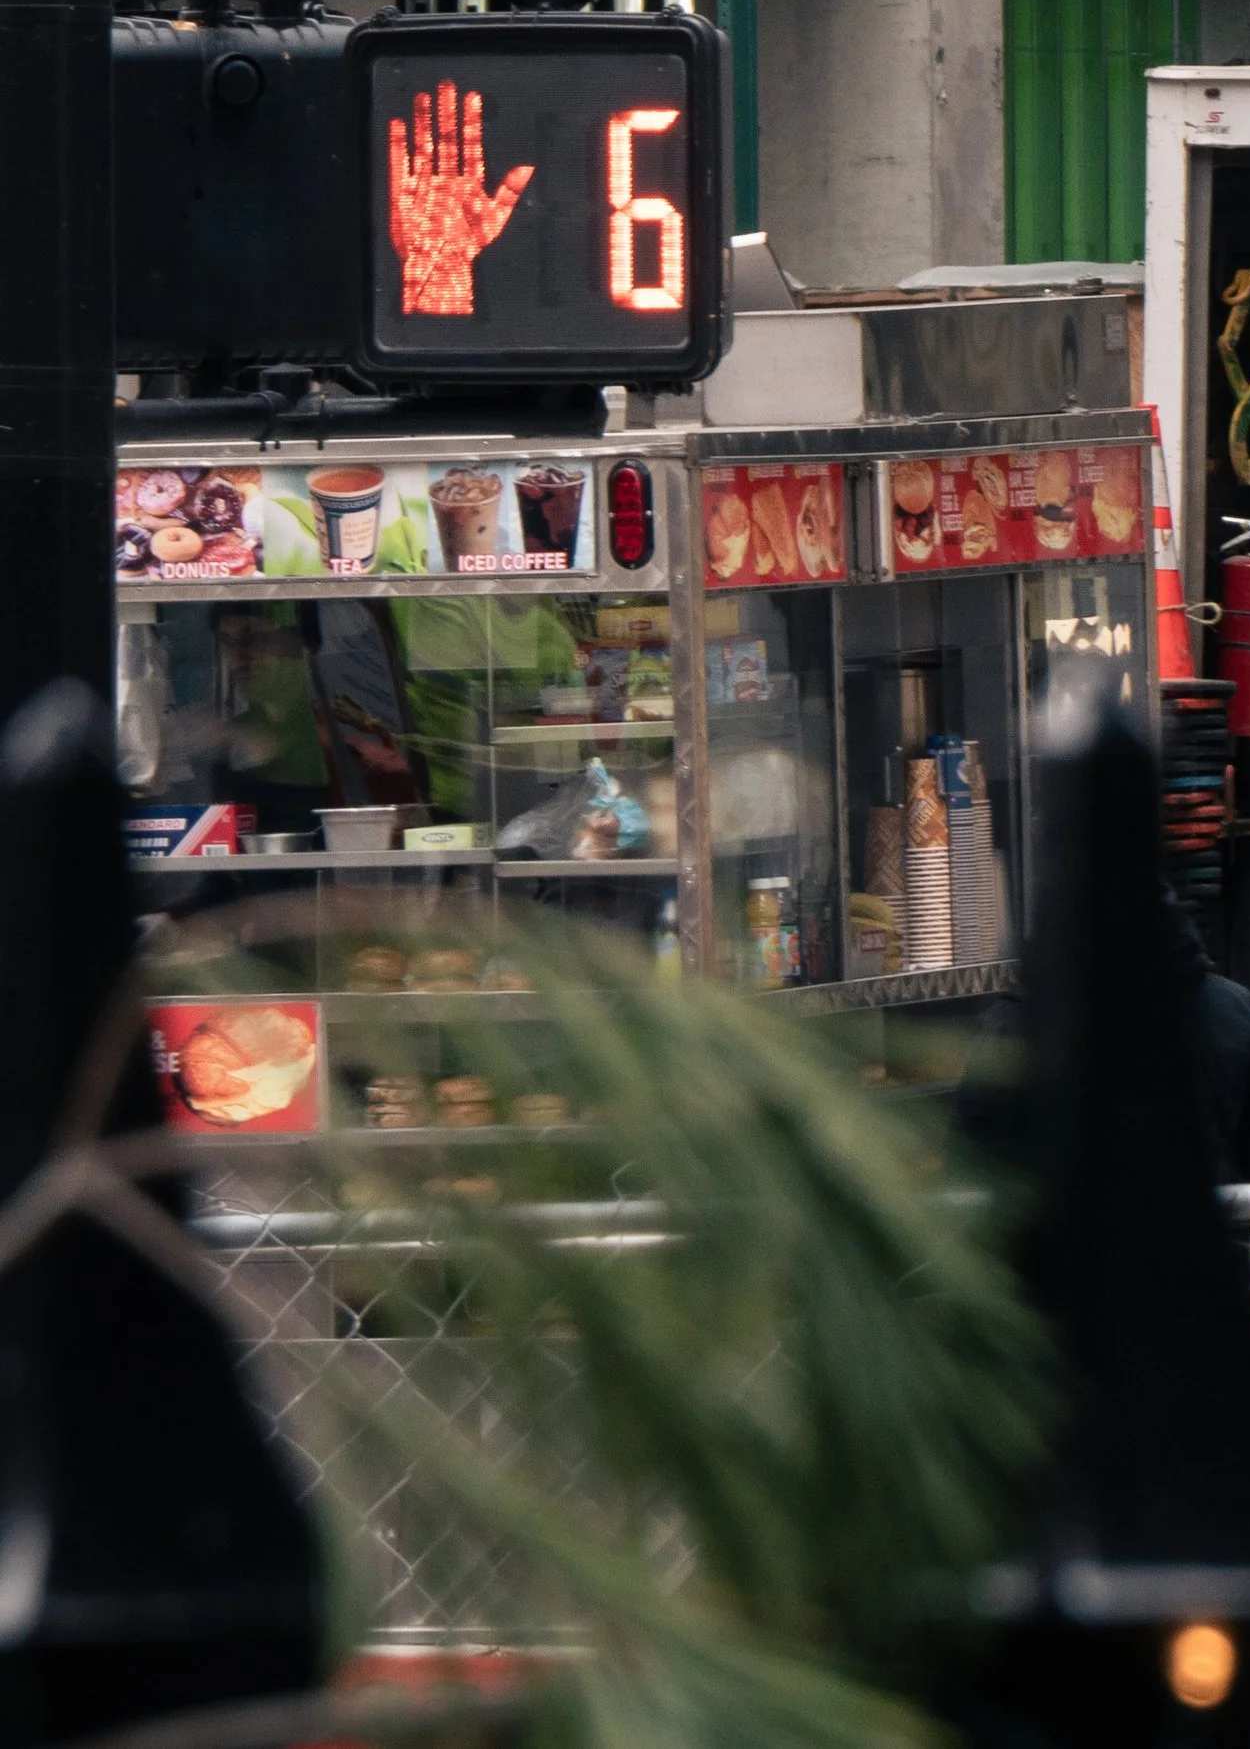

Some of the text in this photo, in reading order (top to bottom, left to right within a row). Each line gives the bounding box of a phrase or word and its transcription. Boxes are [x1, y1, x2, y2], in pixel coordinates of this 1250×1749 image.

[608, 109, 685, 310] 6
[162, 560, 232, 579] DONUTS
[329, 558, 363, 575] TEA
[457, 551, 568, 572] ICED COFFEE
